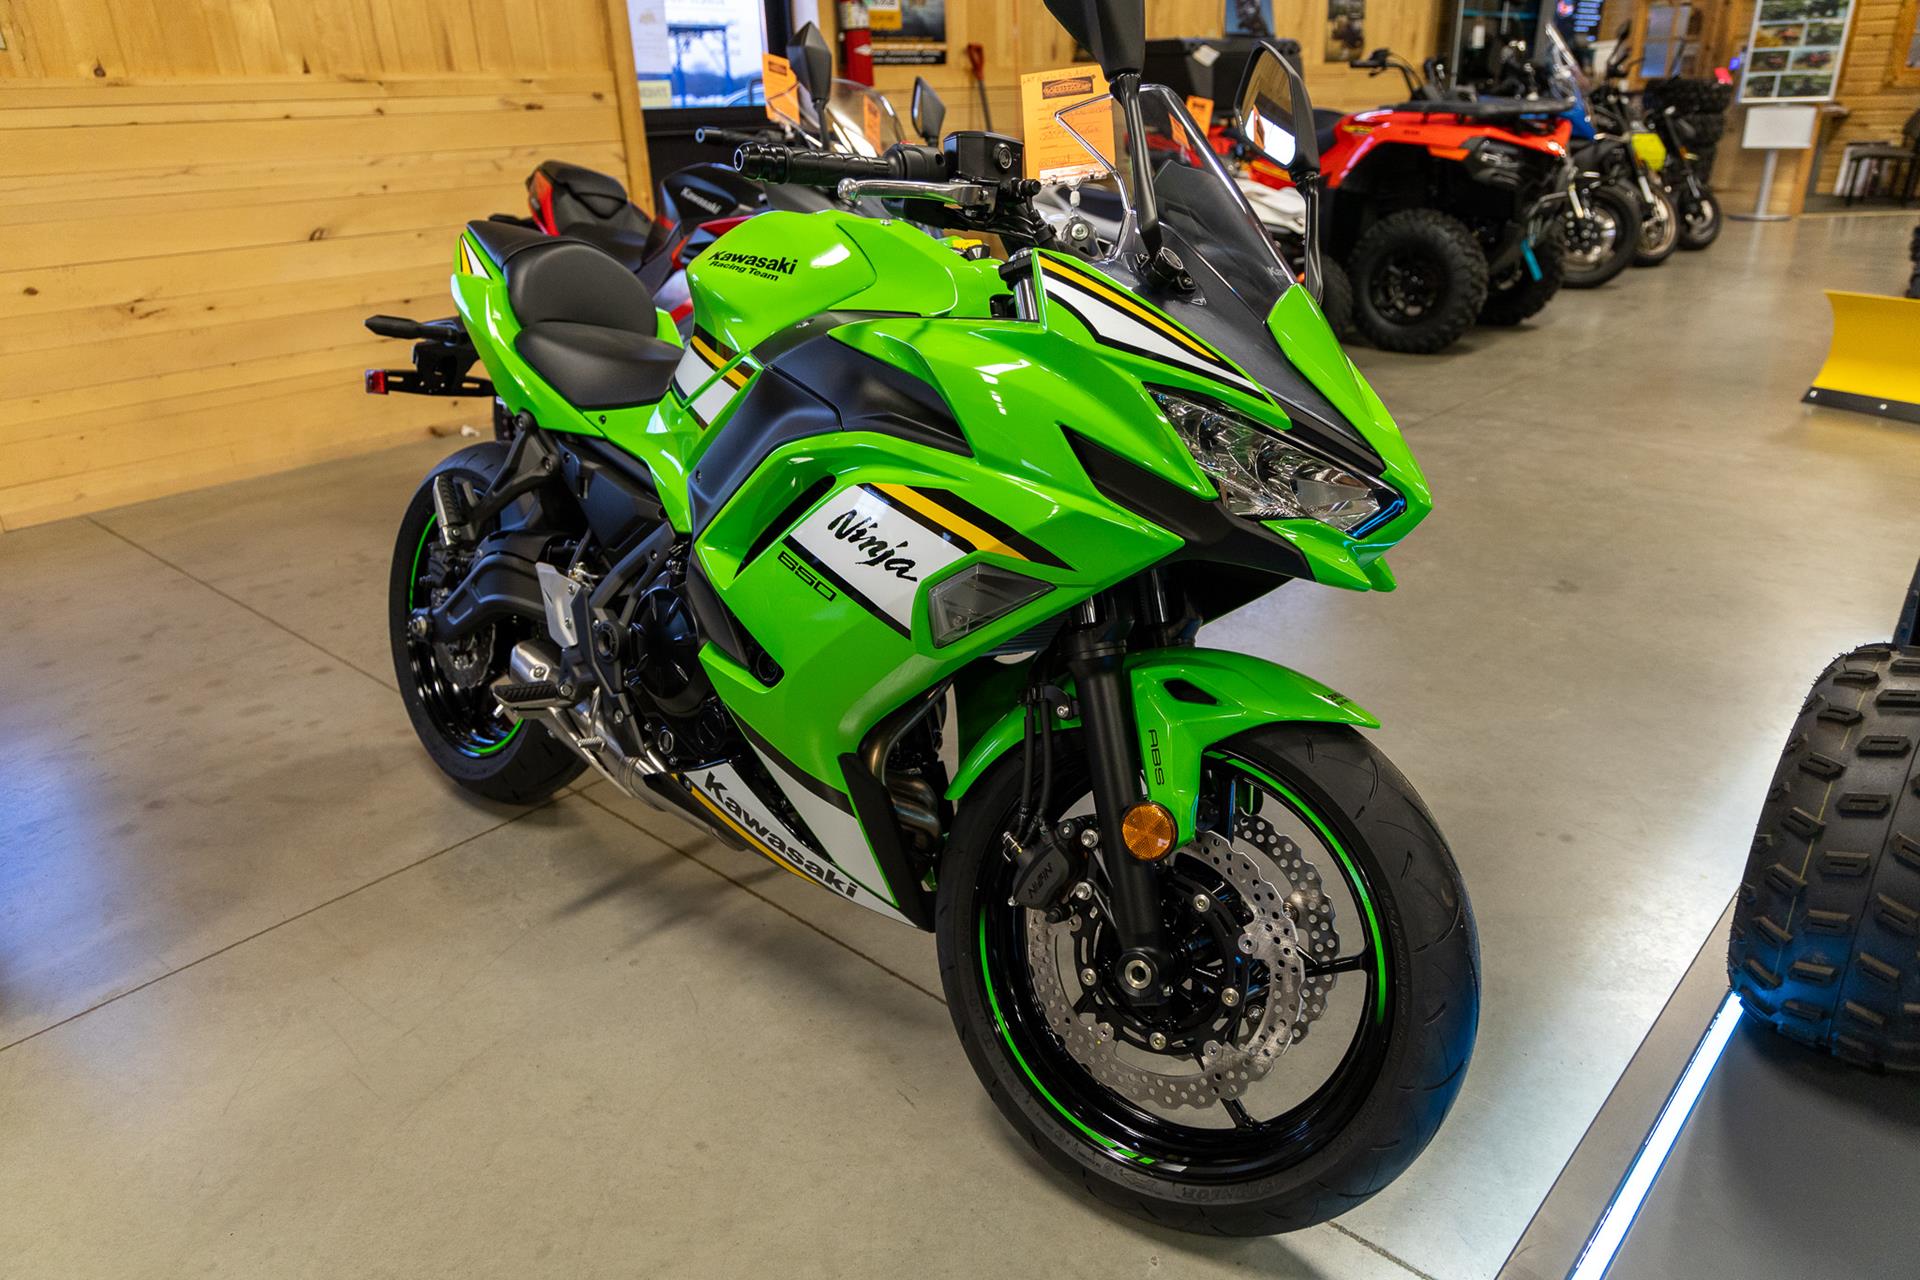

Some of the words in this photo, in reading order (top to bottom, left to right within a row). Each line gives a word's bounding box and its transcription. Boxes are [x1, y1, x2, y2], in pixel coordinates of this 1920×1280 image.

[708, 250, 798, 275] Kawasaki
[709, 260, 747, 273] Racing
[748, 267, 779, 281] Team
[827, 509, 918, 582] Ninja
[777, 550, 837, 602] 650
[1148, 729, 1165, 785] ABS
[704, 771, 858, 898] Kawasaki
